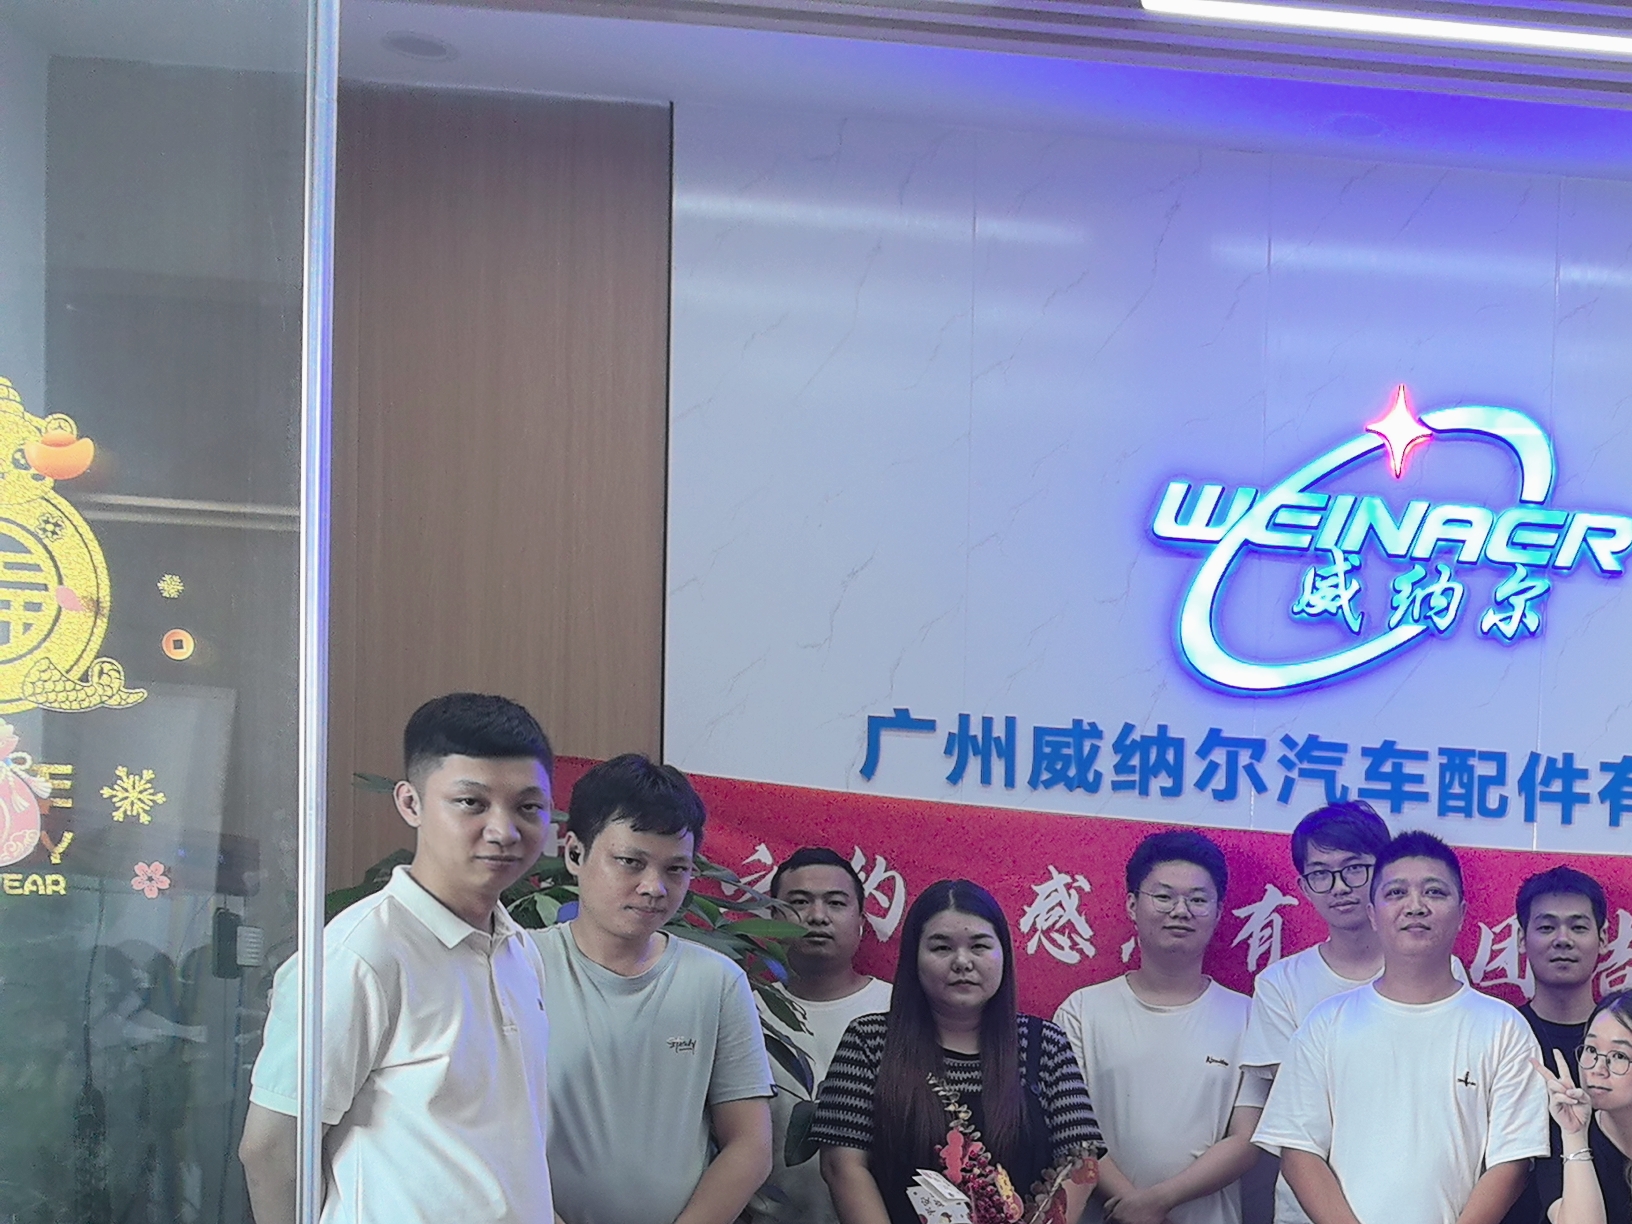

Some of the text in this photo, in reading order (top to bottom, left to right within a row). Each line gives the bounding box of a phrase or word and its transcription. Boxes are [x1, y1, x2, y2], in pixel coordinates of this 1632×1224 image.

[1292, 547, 1550, 639] 威纳尔
[0, 873, 67, 896] EAR
